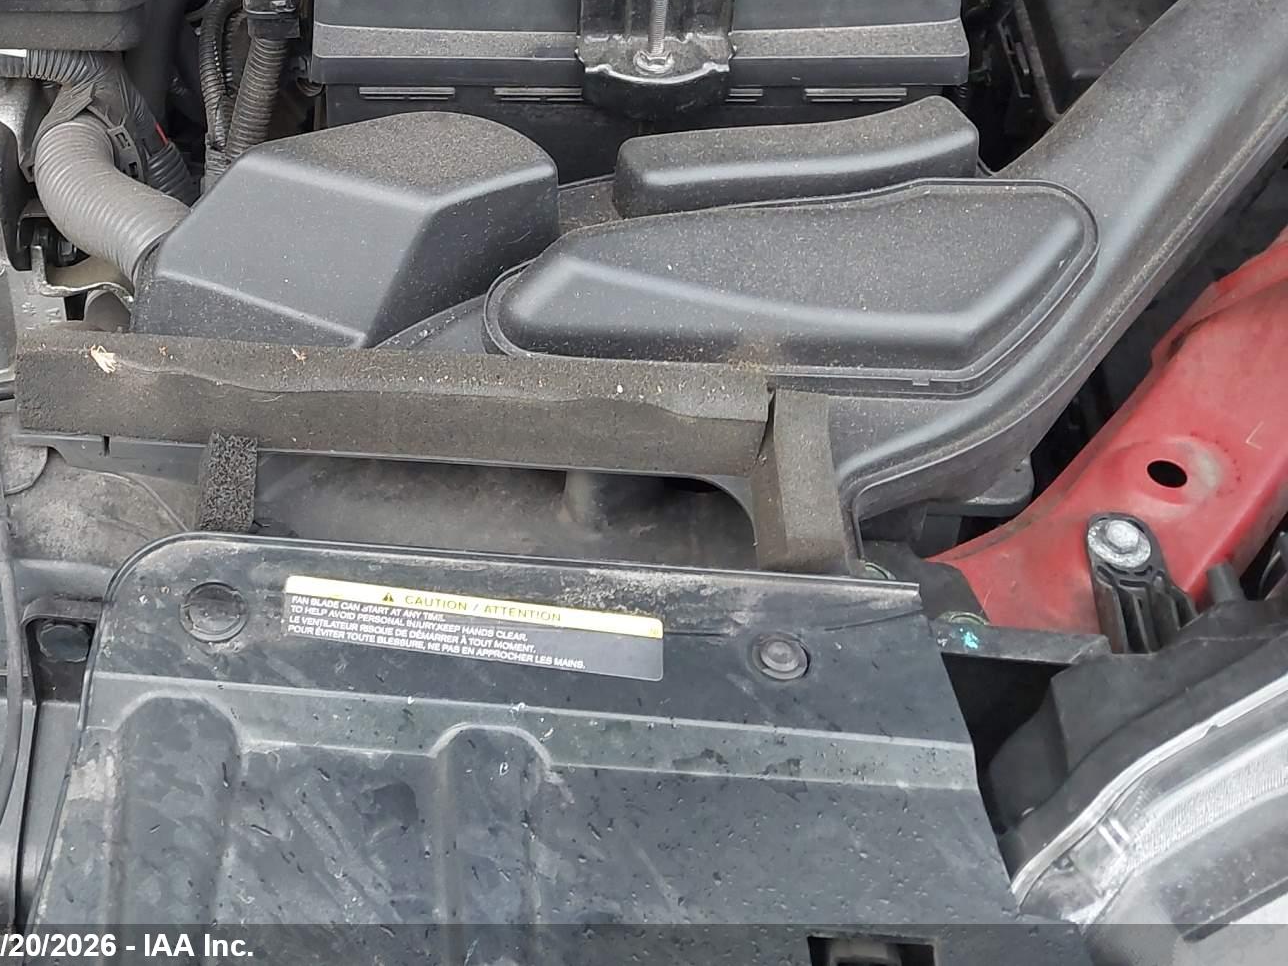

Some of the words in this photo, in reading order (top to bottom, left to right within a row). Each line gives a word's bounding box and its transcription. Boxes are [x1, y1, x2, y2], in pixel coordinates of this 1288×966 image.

[290, 605, 303, 614] TO
[304, 607, 328, 617] HELP
[328, 609, 355, 620] AVOID
[357, 613, 405, 626] PERSONAL
[462, 626, 494, 638] HANDS
[496, 631, 528, 642] CLEAR.
[292, 596, 309, 605] FAN
[310, 598, 339, 609] BLADE
[340, 602, 360, 612] CAN
[361, 605, 388, 615] START
[389, 608, 402, 617] AT
[404, 610, 422, 619] ANY
[405, 595, 468, 611] CAUTION
[484, 604, 562, 622] ATTENTION
[288, 624, 314, 635] POUR
[315, 626, 345, 639] ÉVITER
[346, 632, 375, 643] TOUTE
[377, 636, 426, 650] BLESSURE,
[427, 642, 440, 651] NE
[442, 644, 460, 654] PAS
[462, 646, 475, 655] EN
[476, 648, 534, 663] APPROCHER
[535, 655, 552, 665] LES
[554, 657, 586, 669] MAINS.
[289, 615, 300, 624] LE
[301, 617, 358, 631] VENTILATEUR
[359, 624, 394, 636] RISQUE
[395, 629, 408, 638] DE
[409, 629, 459, 644] DÉMARRER
[461, 635, 468, 645] À
[468, 638, 493, 648] TOUT
[494, 641, 536, 653] MOMENT.
